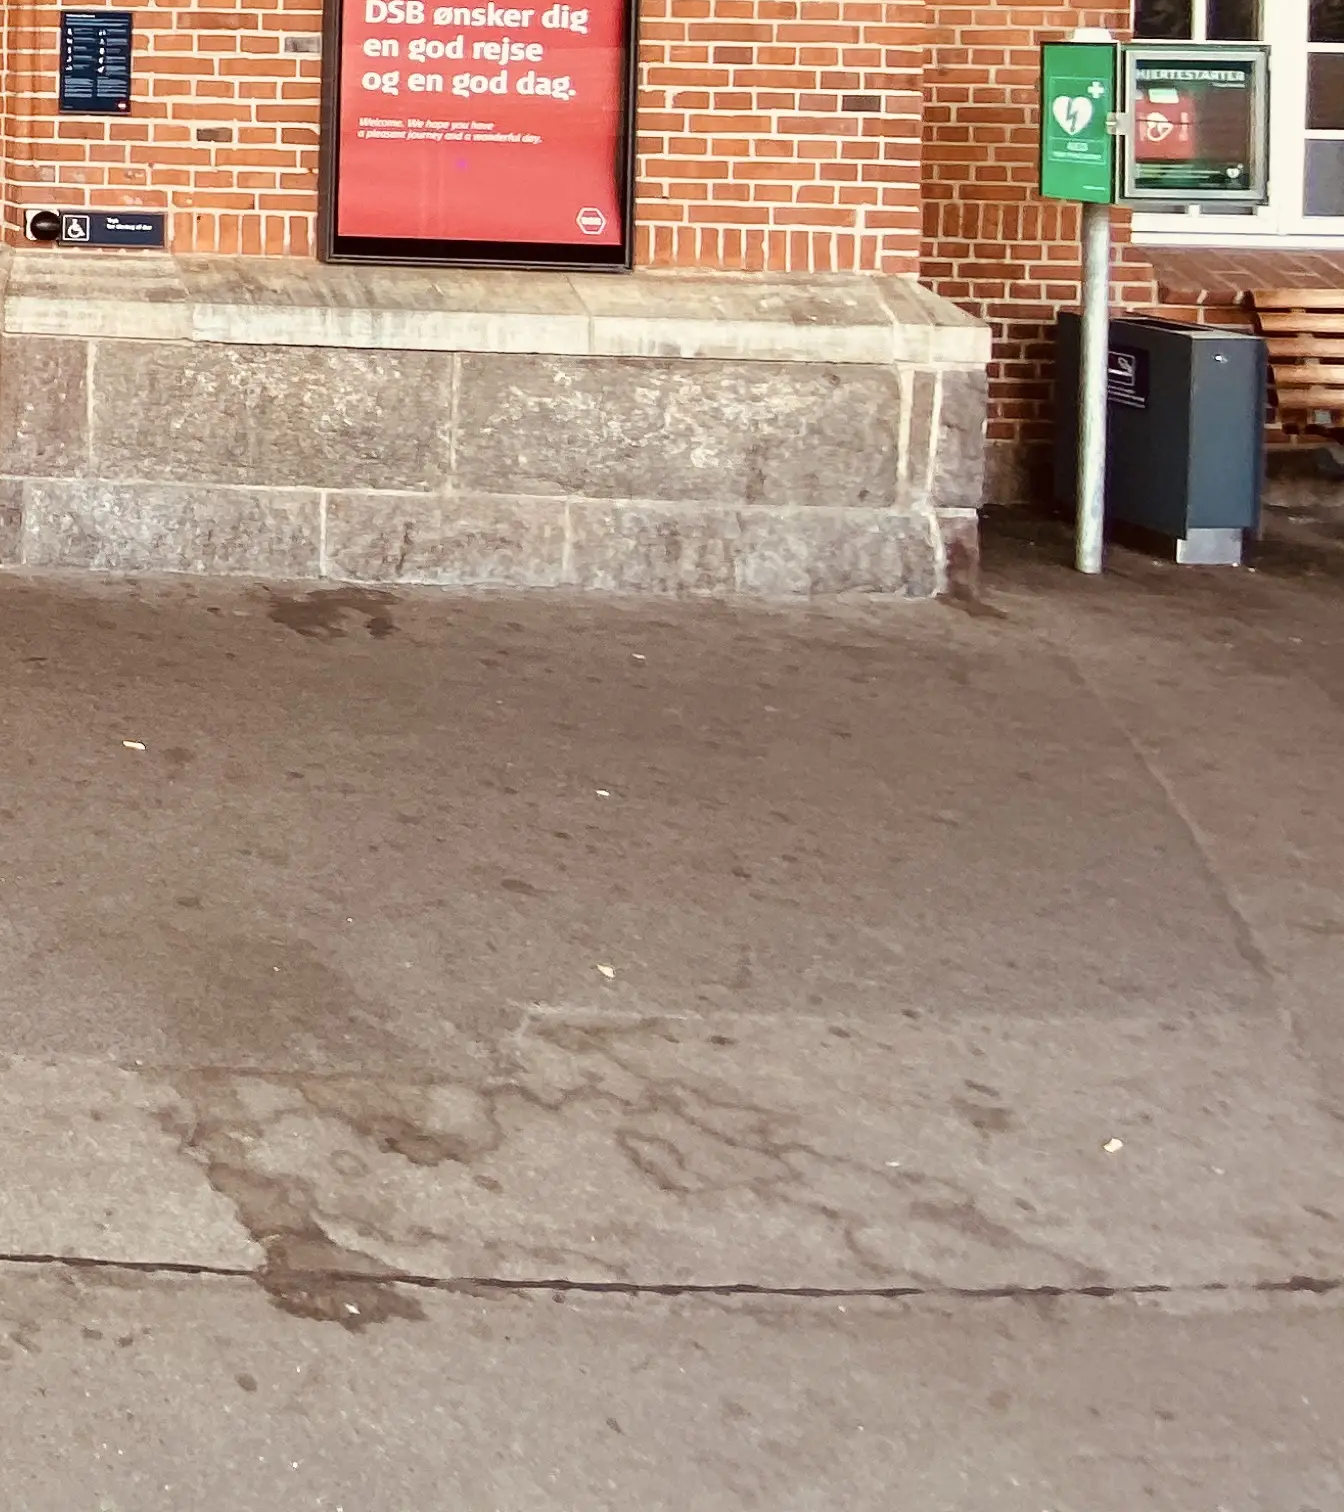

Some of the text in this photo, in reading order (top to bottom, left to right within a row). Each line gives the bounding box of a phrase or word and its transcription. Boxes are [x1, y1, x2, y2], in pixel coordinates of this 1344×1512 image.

[365, 0, 589, 34] DSB ønsker dig
[363, 35, 543, 65] en god rejse
[361, 70, 576, 100] og en god dag.
